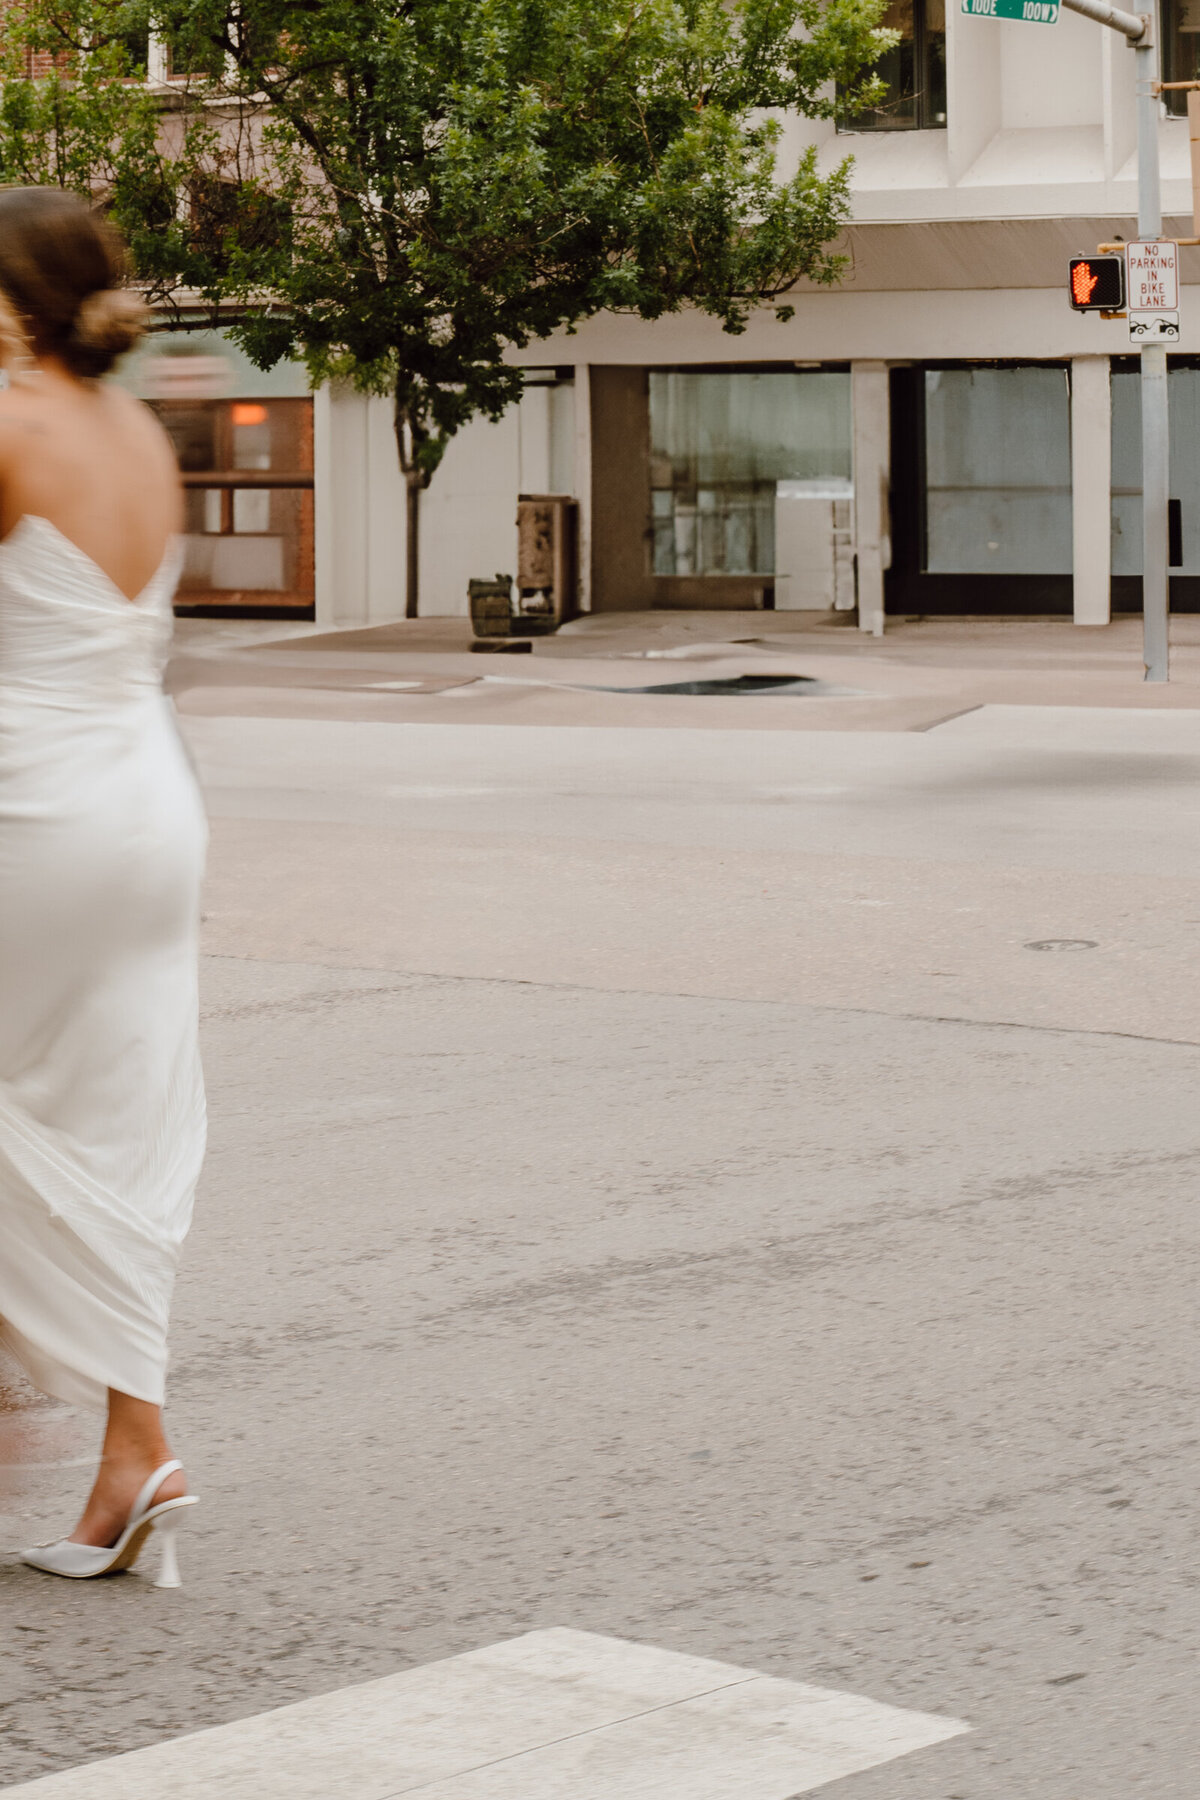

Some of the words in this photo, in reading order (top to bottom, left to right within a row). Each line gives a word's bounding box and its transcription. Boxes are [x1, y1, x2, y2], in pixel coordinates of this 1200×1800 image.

[1022, 0, 1051, 22] 100W
[1144, 245, 1159, 256] NO
[1130, 257, 1175, 269] PARKING
[1147, 270, 1158, 281] IN
[1140, 282, 1165, 294] BIKE
[1140, 295, 1167, 307] LANE
